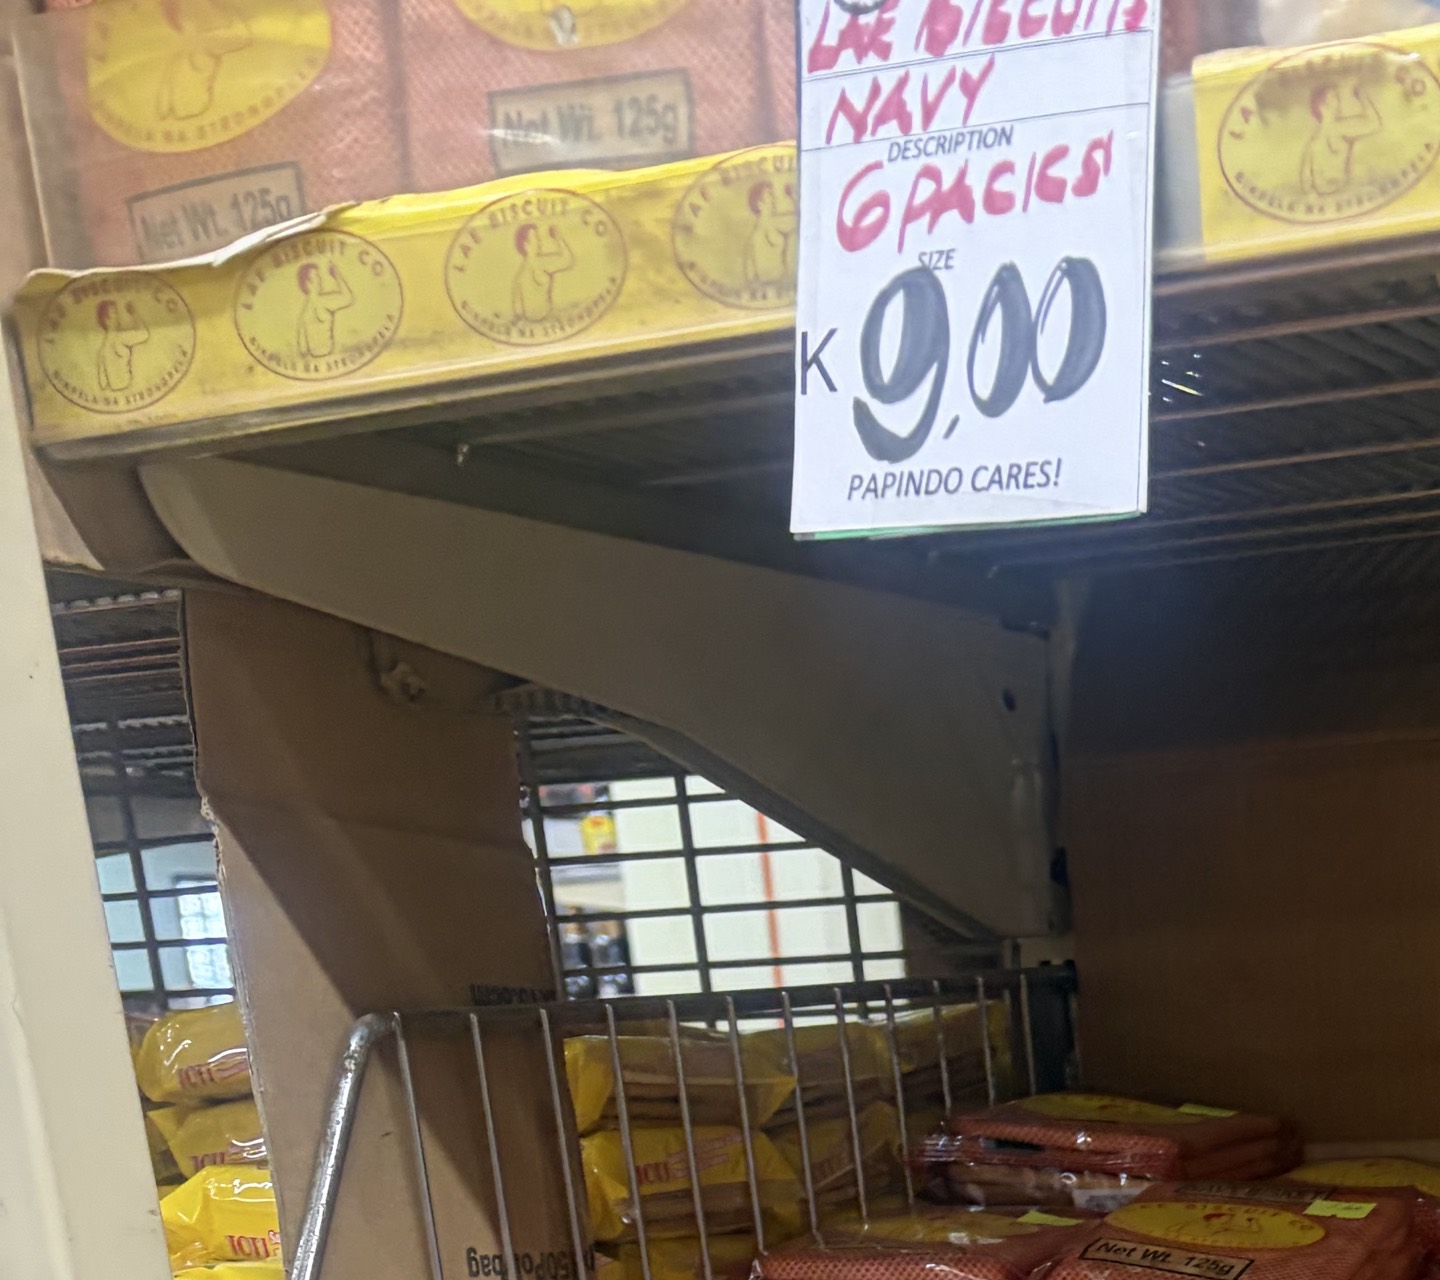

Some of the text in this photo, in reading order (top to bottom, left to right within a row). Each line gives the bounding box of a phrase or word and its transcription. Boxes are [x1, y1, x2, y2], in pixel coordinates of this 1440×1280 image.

[825, 54, 996, 145] NAVY
[613, 96, 681, 143] 125g
[887, 125, 1014, 164] DESCRIPTION
[487, 199, 571, 229] BISCUIT
[916, 247, 957, 272] SIZE
[847, 457, 1063, 502] PAPINDO CARES!
[1096, 1241, 1136, 1260] Net
[1181, 1251, 1236, 1279] 125g
